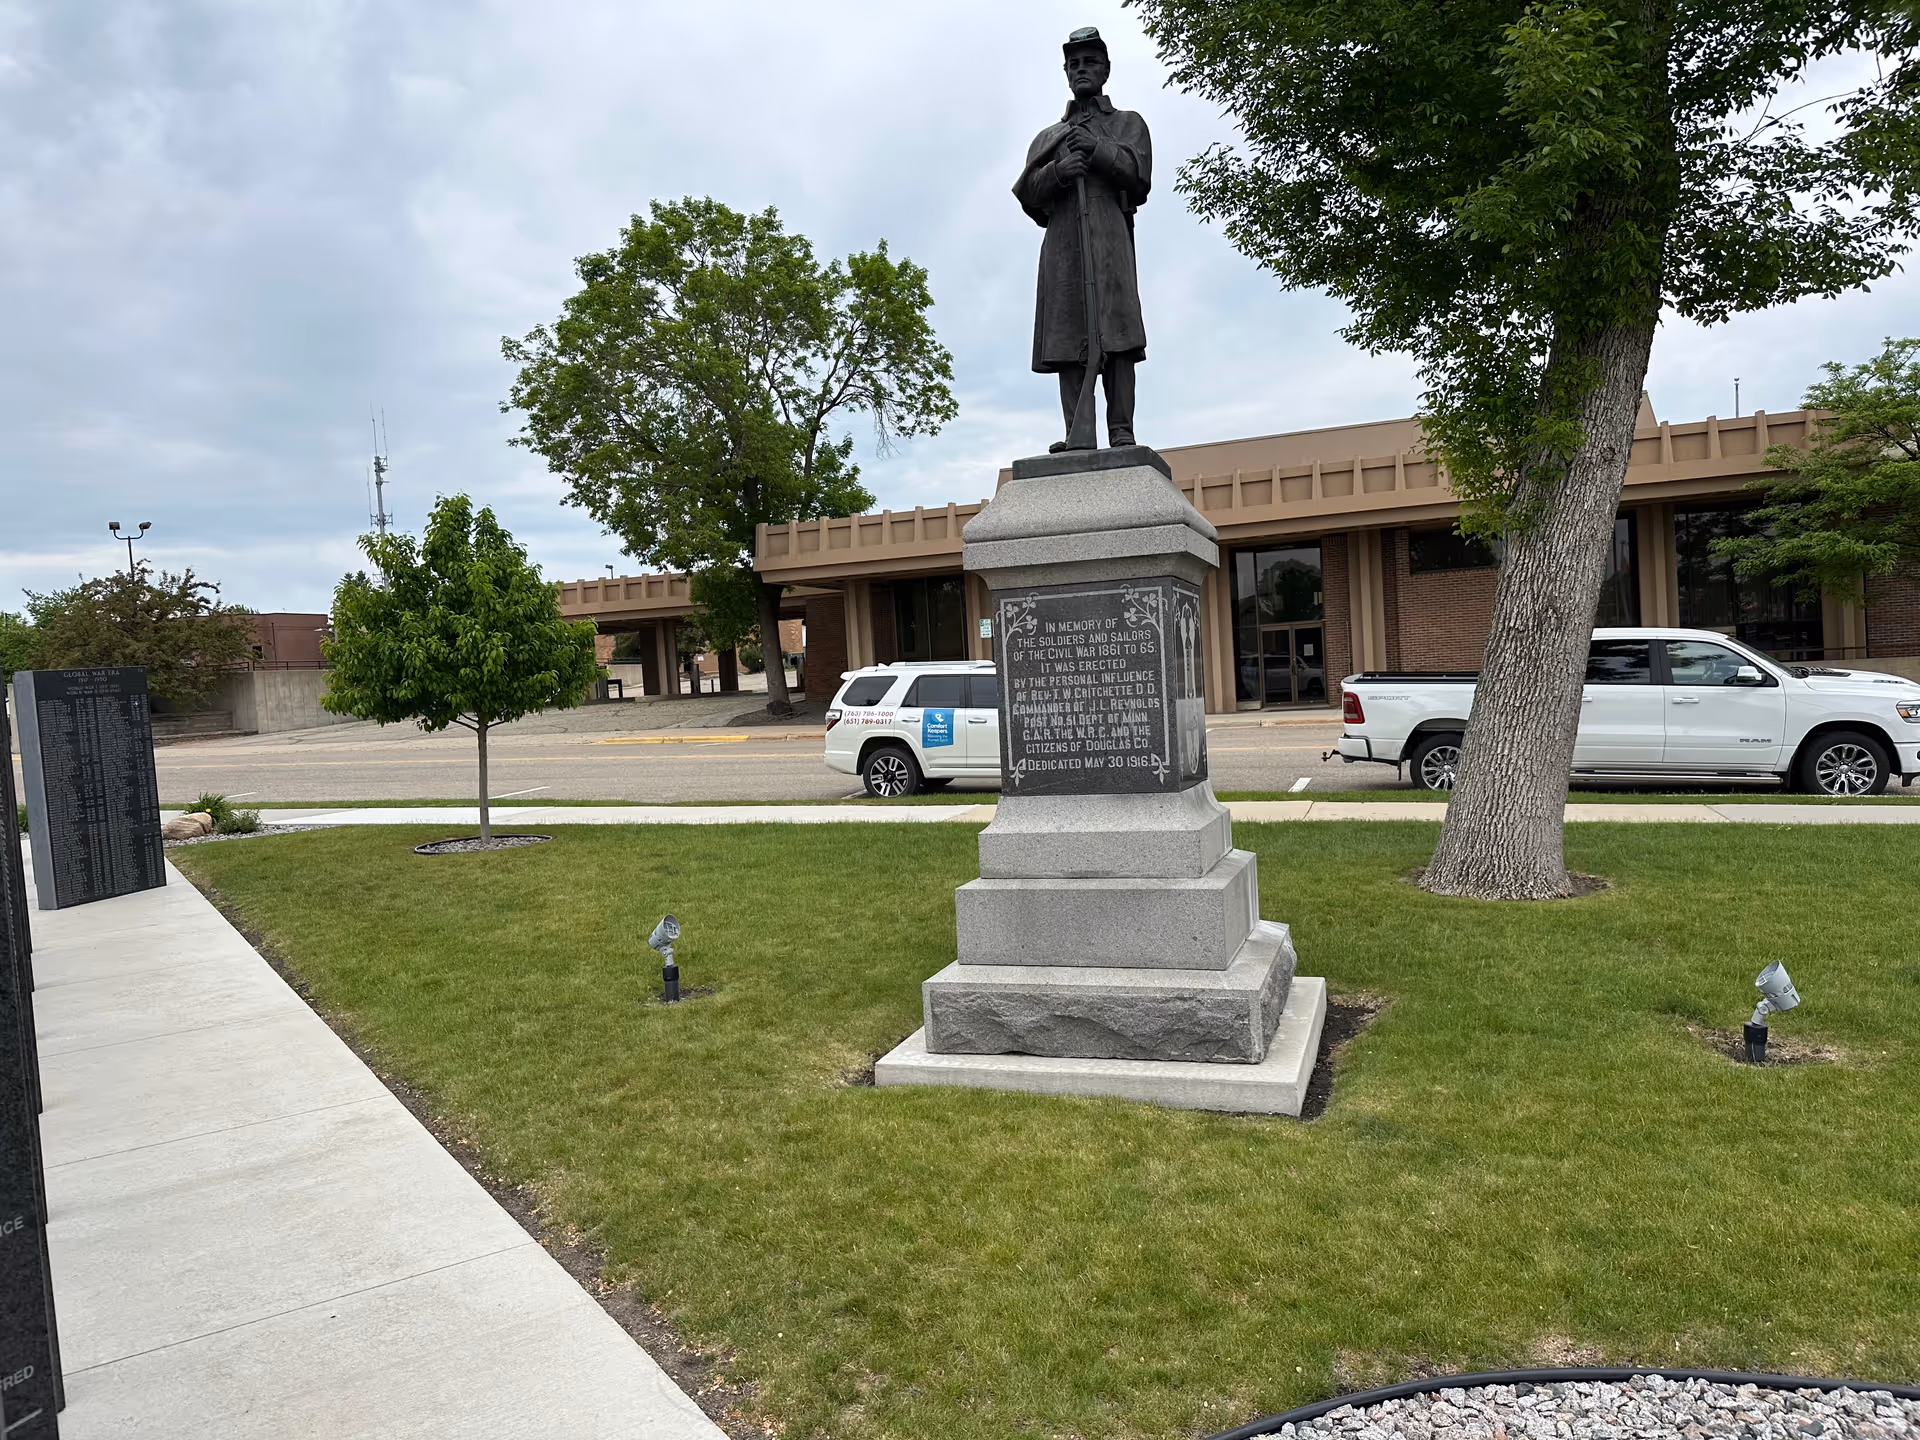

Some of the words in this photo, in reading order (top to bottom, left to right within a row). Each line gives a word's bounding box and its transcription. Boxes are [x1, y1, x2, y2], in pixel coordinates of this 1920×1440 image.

[1045, 622, 1056, 632] IN
[1058, 620, 1101, 632] MEMORY
[1105, 618, 1118, 628] OF
[1016, 637, 1036, 648] THE
[1039, 634, 1084, 647] SOLDIERS
[1089, 632, 1108, 643] AND
[1110, 630, 1151, 642] SAILORS
[1013, 651, 1025, 661] OF
[1028, 650, 1046, 660] THE
[1048, 648, 1073, 659] CIVIL
[1076, 645, 1096, 657] WAR
[1098, 644, 1120, 656] 1861
[1124, 644, 1136, 654] TO
[1041, 662, 1050, 673] IT
[1055, 662, 1075, 672] WAS
[1079, 658, 1126, 671] ERECTED
[1014, 678, 1026, 688] BY
[1028, 677, 1046, 687] THE
[1049, 673, 1098, 686] PERSONAL
[1101, 670, 1155, 684] INFLUENCE
[1016, 691, 1027, 701] OF
[1074, 686, 1133, 698] CRITCHETTE
[1012, 702, 1071, 715] COMMANDER
[1073, 701, 1085, 712] OF
[1110, 698, 1160, 710] REYNOLDS
[1024, 716, 1047, 728] POST
[1107, 714, 1119, 724] OF
[1054, 728, 1073, 739] THE
[1111, 725, 1129, 737] AND
[1132, 725, 1151, 736] THE
[1026, 742, 1068, 754] CITIZENS
[1070, 741, 1081, 752] OF
[1086, 740, 1131, 751] DOUGLAS
[1028, 758, 1081, 770] DEDICATED
[1085, 756, 1104, 768] MAY
[1108, 756, 1124, 768] 30
[0, 1216, 24, 1237] CE
